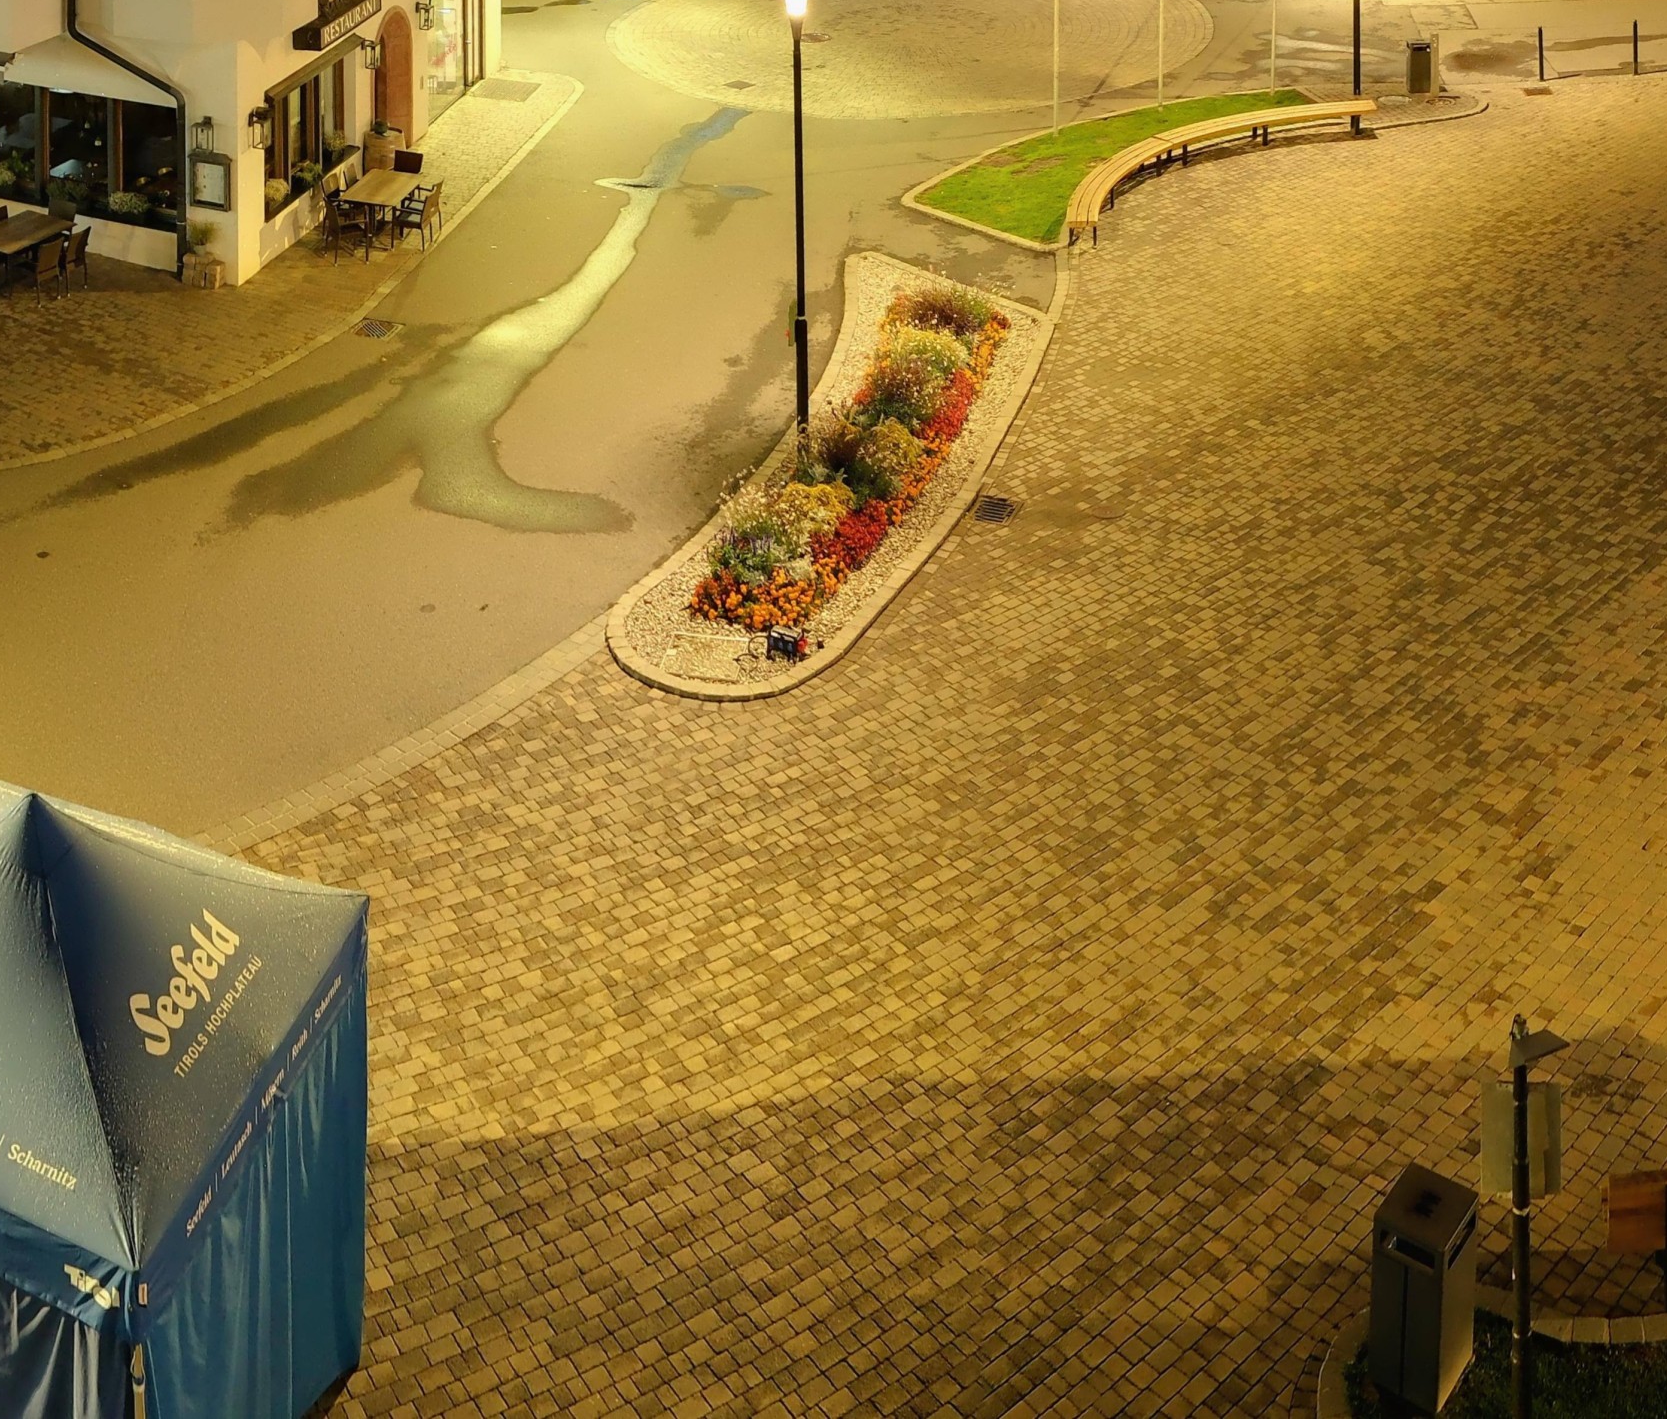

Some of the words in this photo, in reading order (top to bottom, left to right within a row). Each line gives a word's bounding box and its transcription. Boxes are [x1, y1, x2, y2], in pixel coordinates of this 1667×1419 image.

[128, 907, 241, 1057] Seefeld
[172, 1031, 209, 1079] TIROLS
[204, 955, 263, 1035] HOCHPLATEAU
[6, 1143, 78, 1190] Scharnitz
[186, 1184, 213, 1239] Seefeld
[220, 1120, 254, 1180] Leutasch
[291, 1028, 309, 1062] Reith
